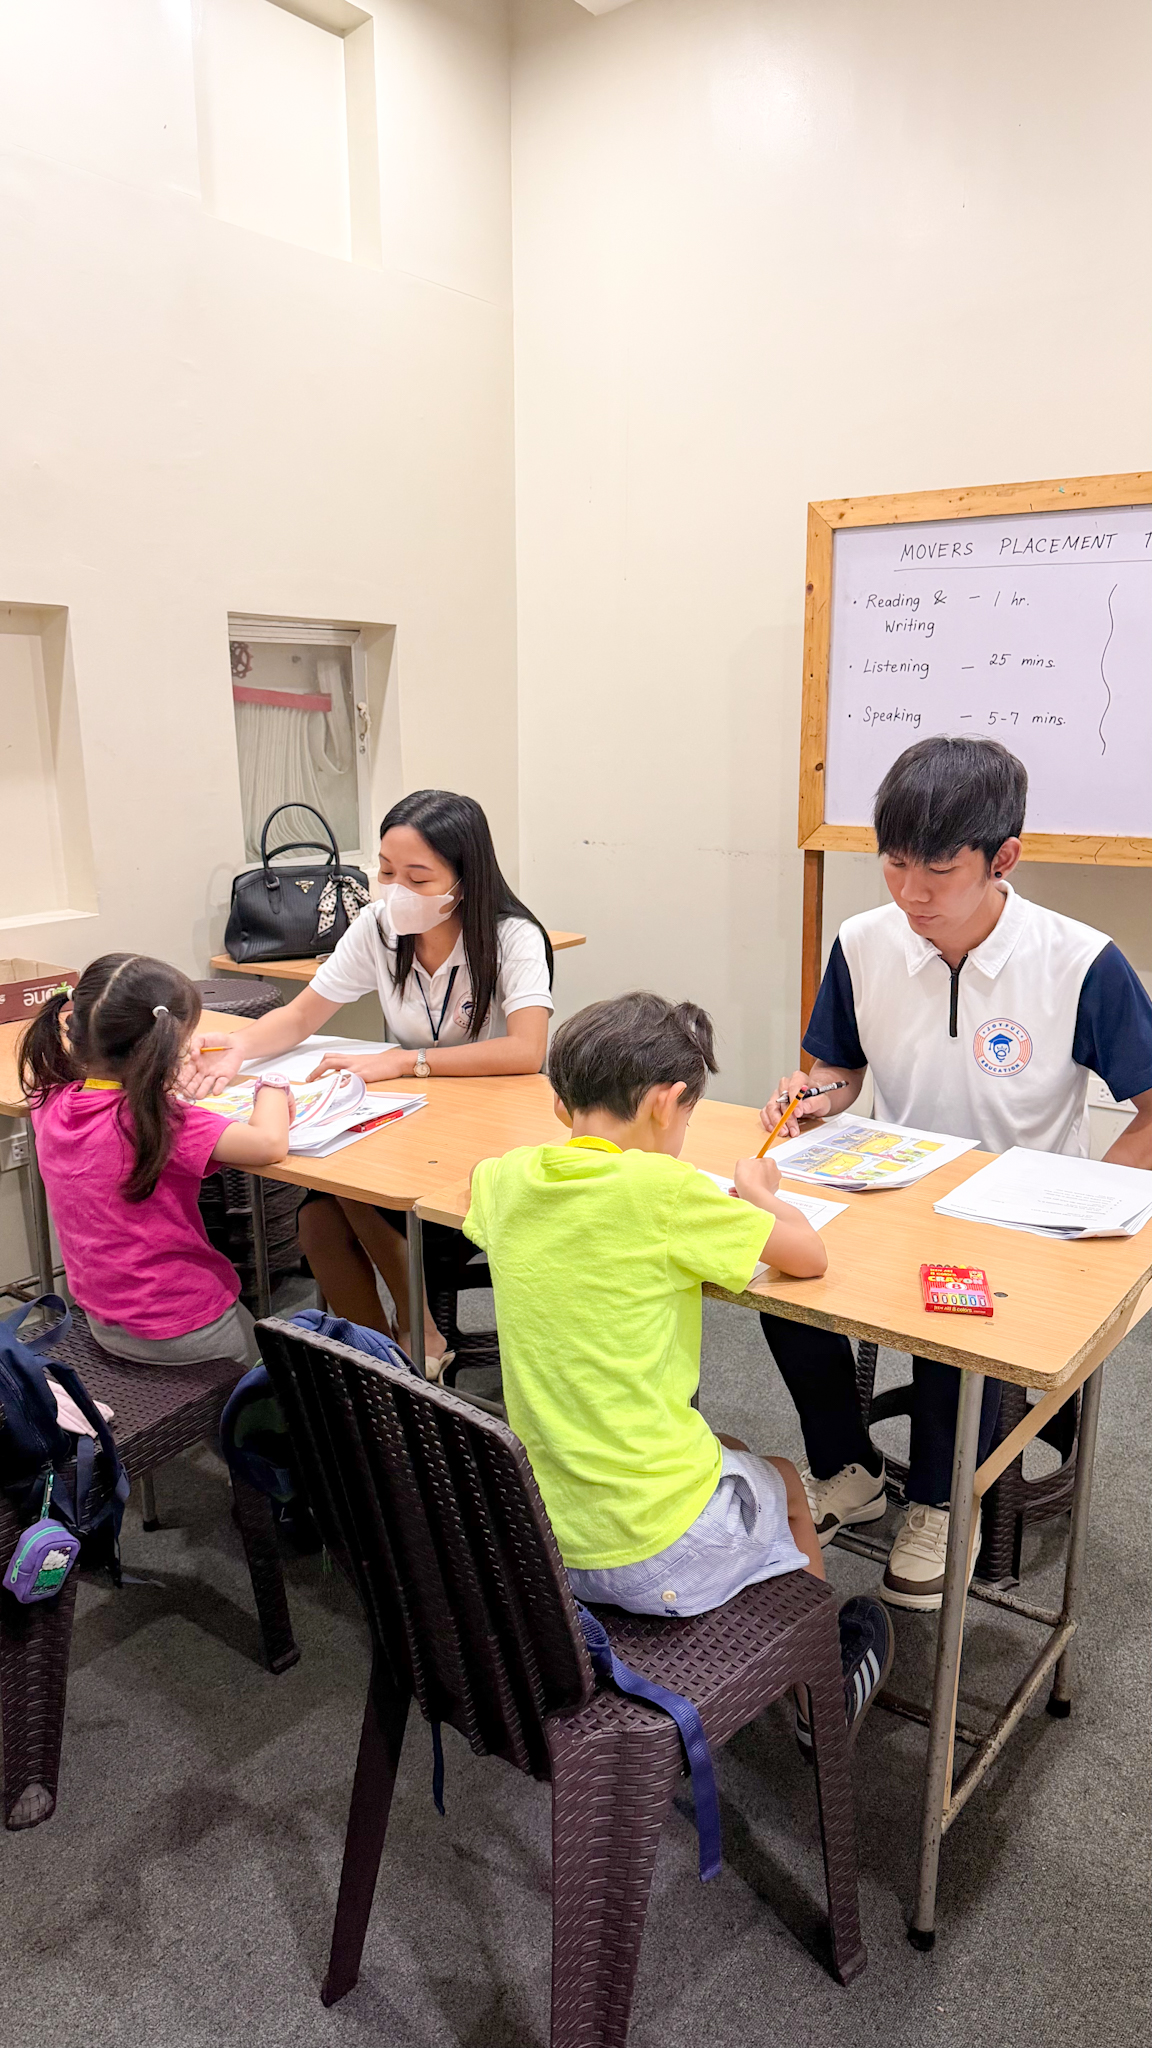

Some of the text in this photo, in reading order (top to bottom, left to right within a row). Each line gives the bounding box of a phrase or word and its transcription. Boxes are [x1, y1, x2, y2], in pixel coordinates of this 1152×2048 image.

[900, 542, 974, 562] MOVERS
[999, 532, 1119, 555] PLACEMENT
[865, 593, 920, 612] Reading
[933, 589, 948, 605] &
[993, 590, 1001, 607] 1
[1010, 591, 1030, 606] hr.
[885, 618, 935, 638] Writing
[863, 658, 929, 680] Listening
[989, 653, 1012, 666] 25
[1021, 654, 1055, 668] mins.
[862, 705, 922, 730] Speaking
[987, 711, 1019, 726] 5-7
[1032, 711, 1066, 726] mins.
[987, 1023, 1020, 1035] JOYFUL
[981, 1060, 1020, 1073] EDUCATION
[927, 1276, 984, 1285] CRAYON
